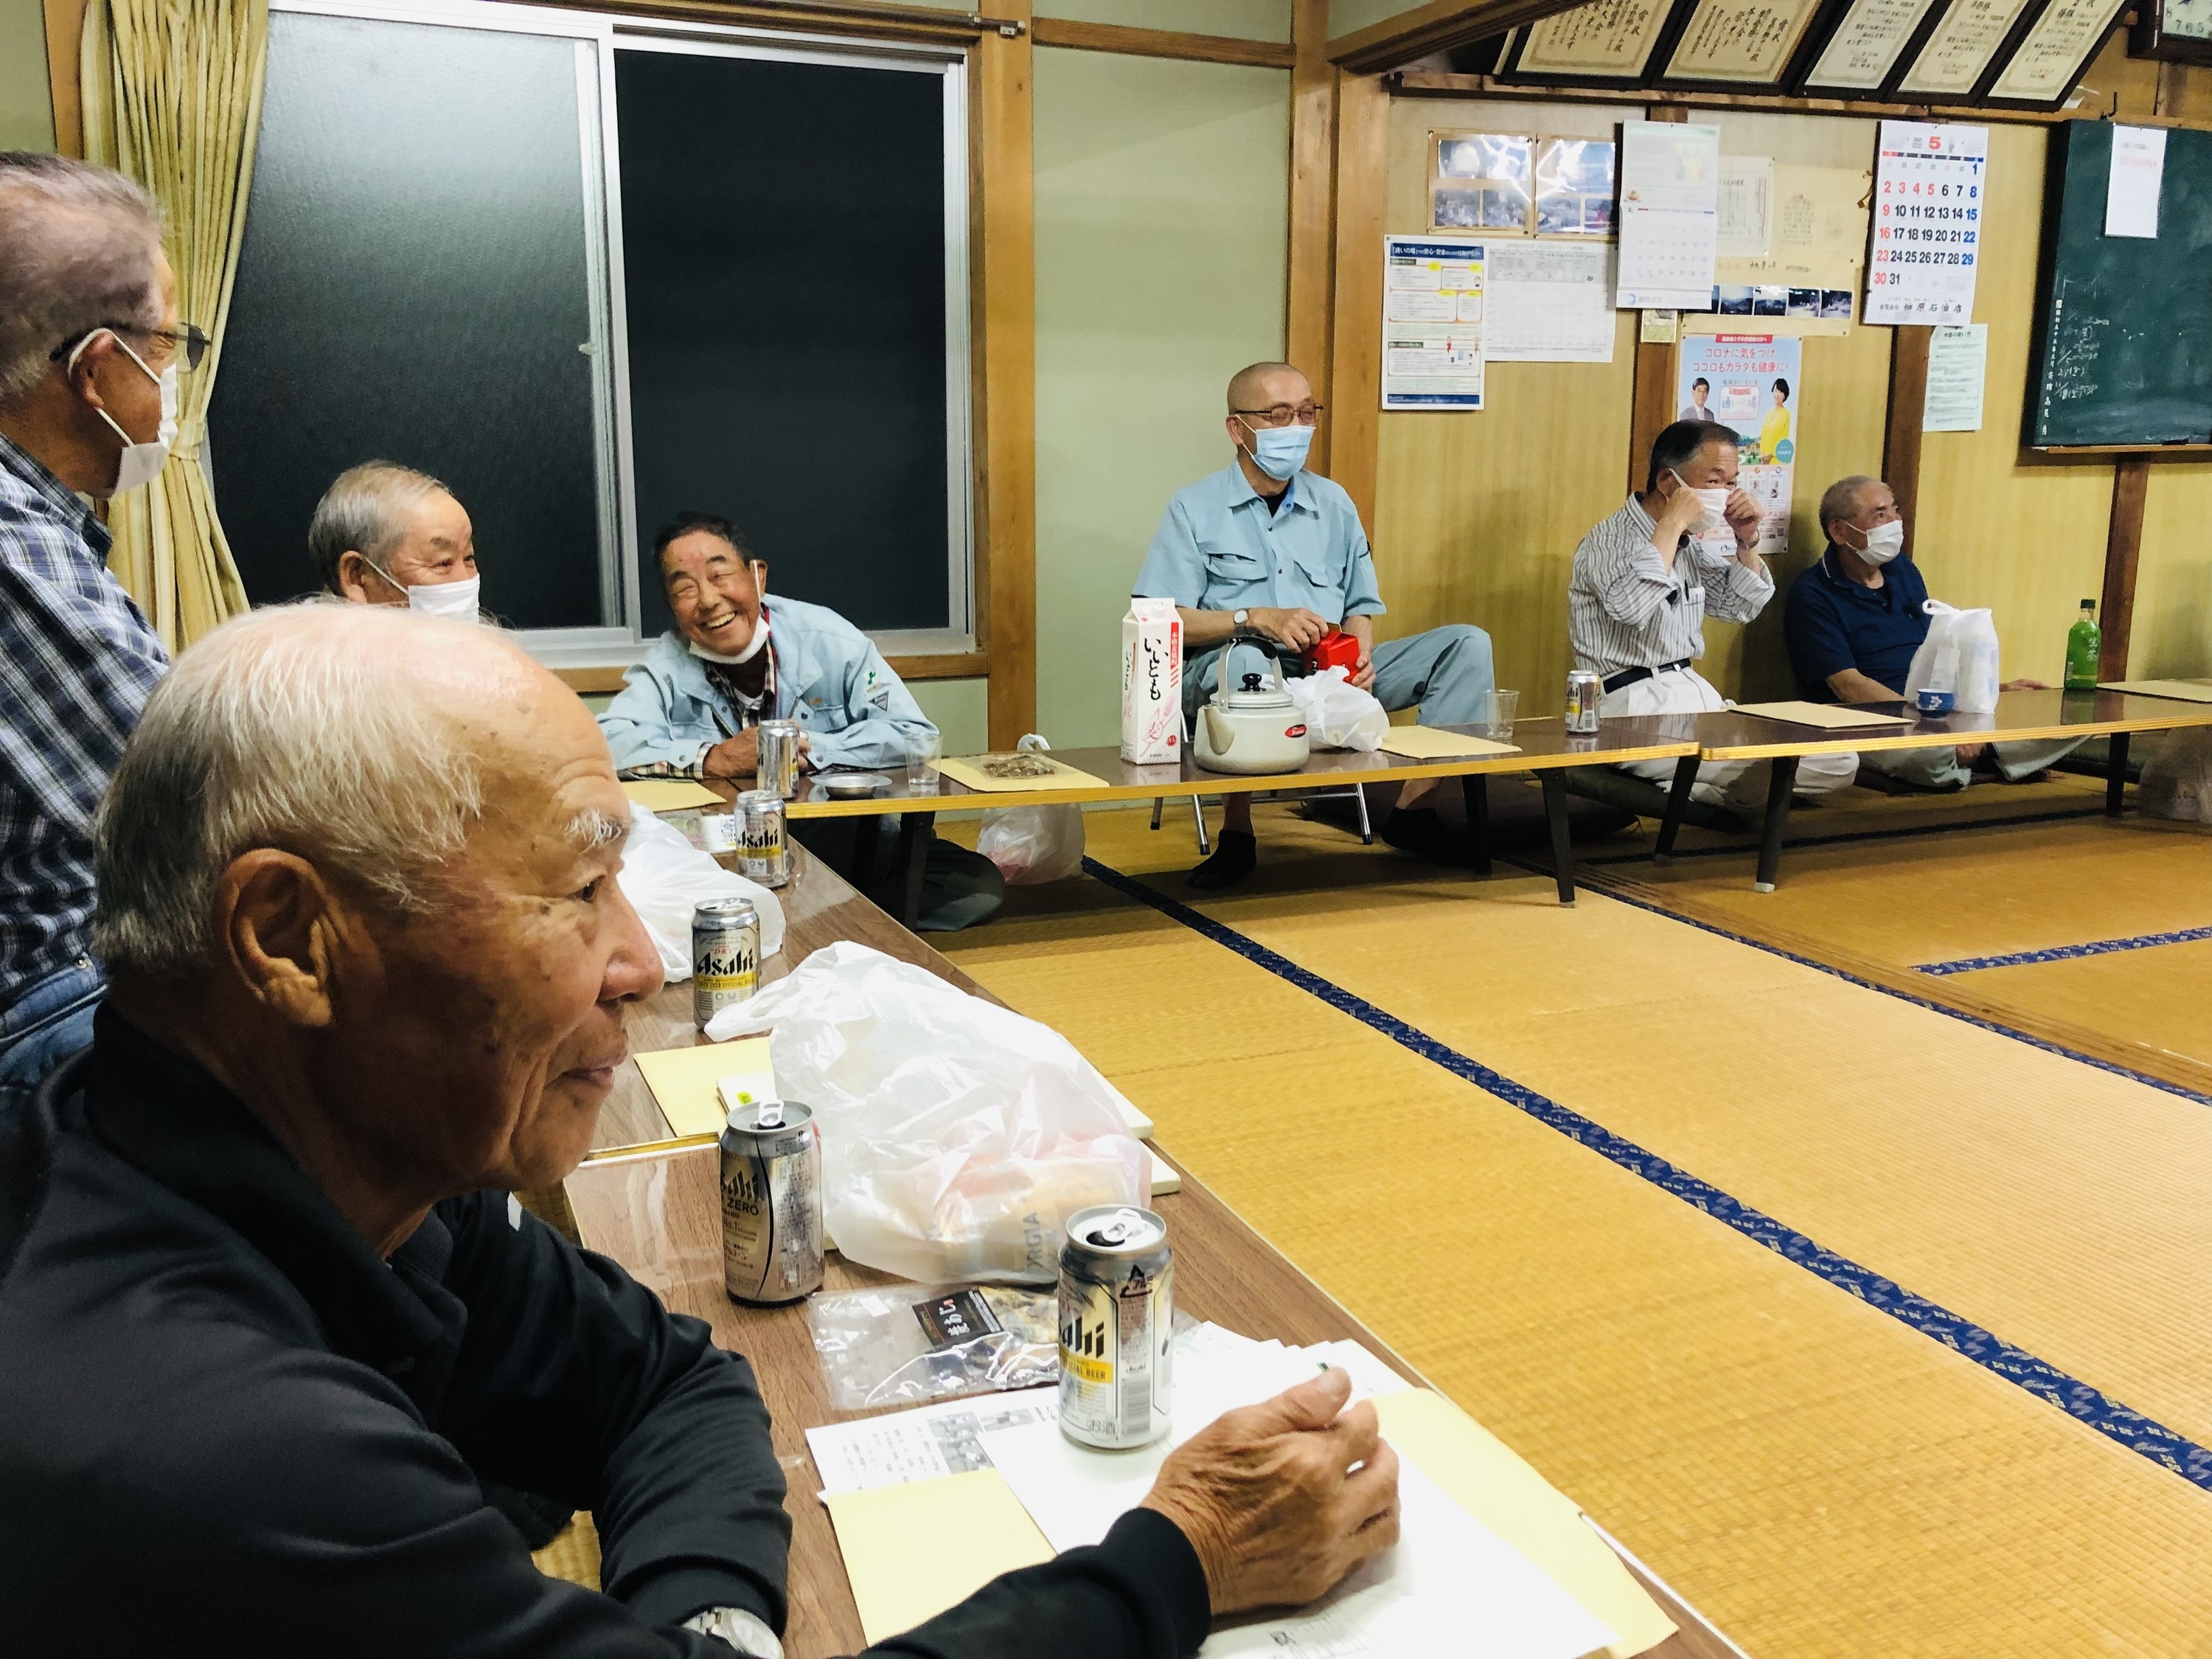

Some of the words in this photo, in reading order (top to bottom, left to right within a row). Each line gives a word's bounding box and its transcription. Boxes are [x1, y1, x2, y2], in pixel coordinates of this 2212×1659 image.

[1929, 136, 1941, 150] 5
[1972, 164, 1978, 175] 1
[1884, 181, 1891, 194] 2
[1899, 182, 1906, 195] 3
[1913, 183, 1920, 195] 4
[1927, 184, 1935, 196] 5
[1941, 184, 1949, 197] 6
[1956, 185, 1964, 198] 7
[1969, 186, 1978, 198] 8
[1882, 204, 1891, 217] 9
[1895, 205, 1907, 217] 10
[1910, 206, 1921, 218] 11
[1924, 206, 1935, 218] 12
[1938, 207, 1950, 219] 13
[1952, 208, 1964, 220] 14
[1966, 209, 1978, 220] 15
[1879, 226, 1891, 240] 16
[1893, 227, 1905, 240] 17
[1907, 229, 1919, 240] 18
[1921, 229, 1933, 241] 19
[1935, 229, 1947, 242] 20
[1950, 230, 1961, 243] 21
[1963, 231, 1976, 243] 22
[1876, 249, 1889, 262] 23
[1891, 250, 1903, 262] 24
[1905, 251, 1917, 263] 25
[1919, 251, 1931, 264] 26
[1933, 252, 1946, 264] 27
[1947, 253, 1959, 265] 28
[1961, 253, 1974, 265] 29
[1874, 272, 1887, 285] 30
[1889, 273, 1900, 285] 31
[1705, 348, 1777, 358] コロナに気をつけ、
[2086, 636, 2098, 661] 生茶
[1144, 637, 1169, 700] いいとも
[737, 828, 779, 849] Asahi
[697, 948, 754, 976] Asahi
[727, 1197, 759, 1216] ZERO
[1060, 1316, 1105, 1359] ahi
[1086, 1368, 1106, 1380] BEER
[1089, 1417, 1116, 1434] お酒
